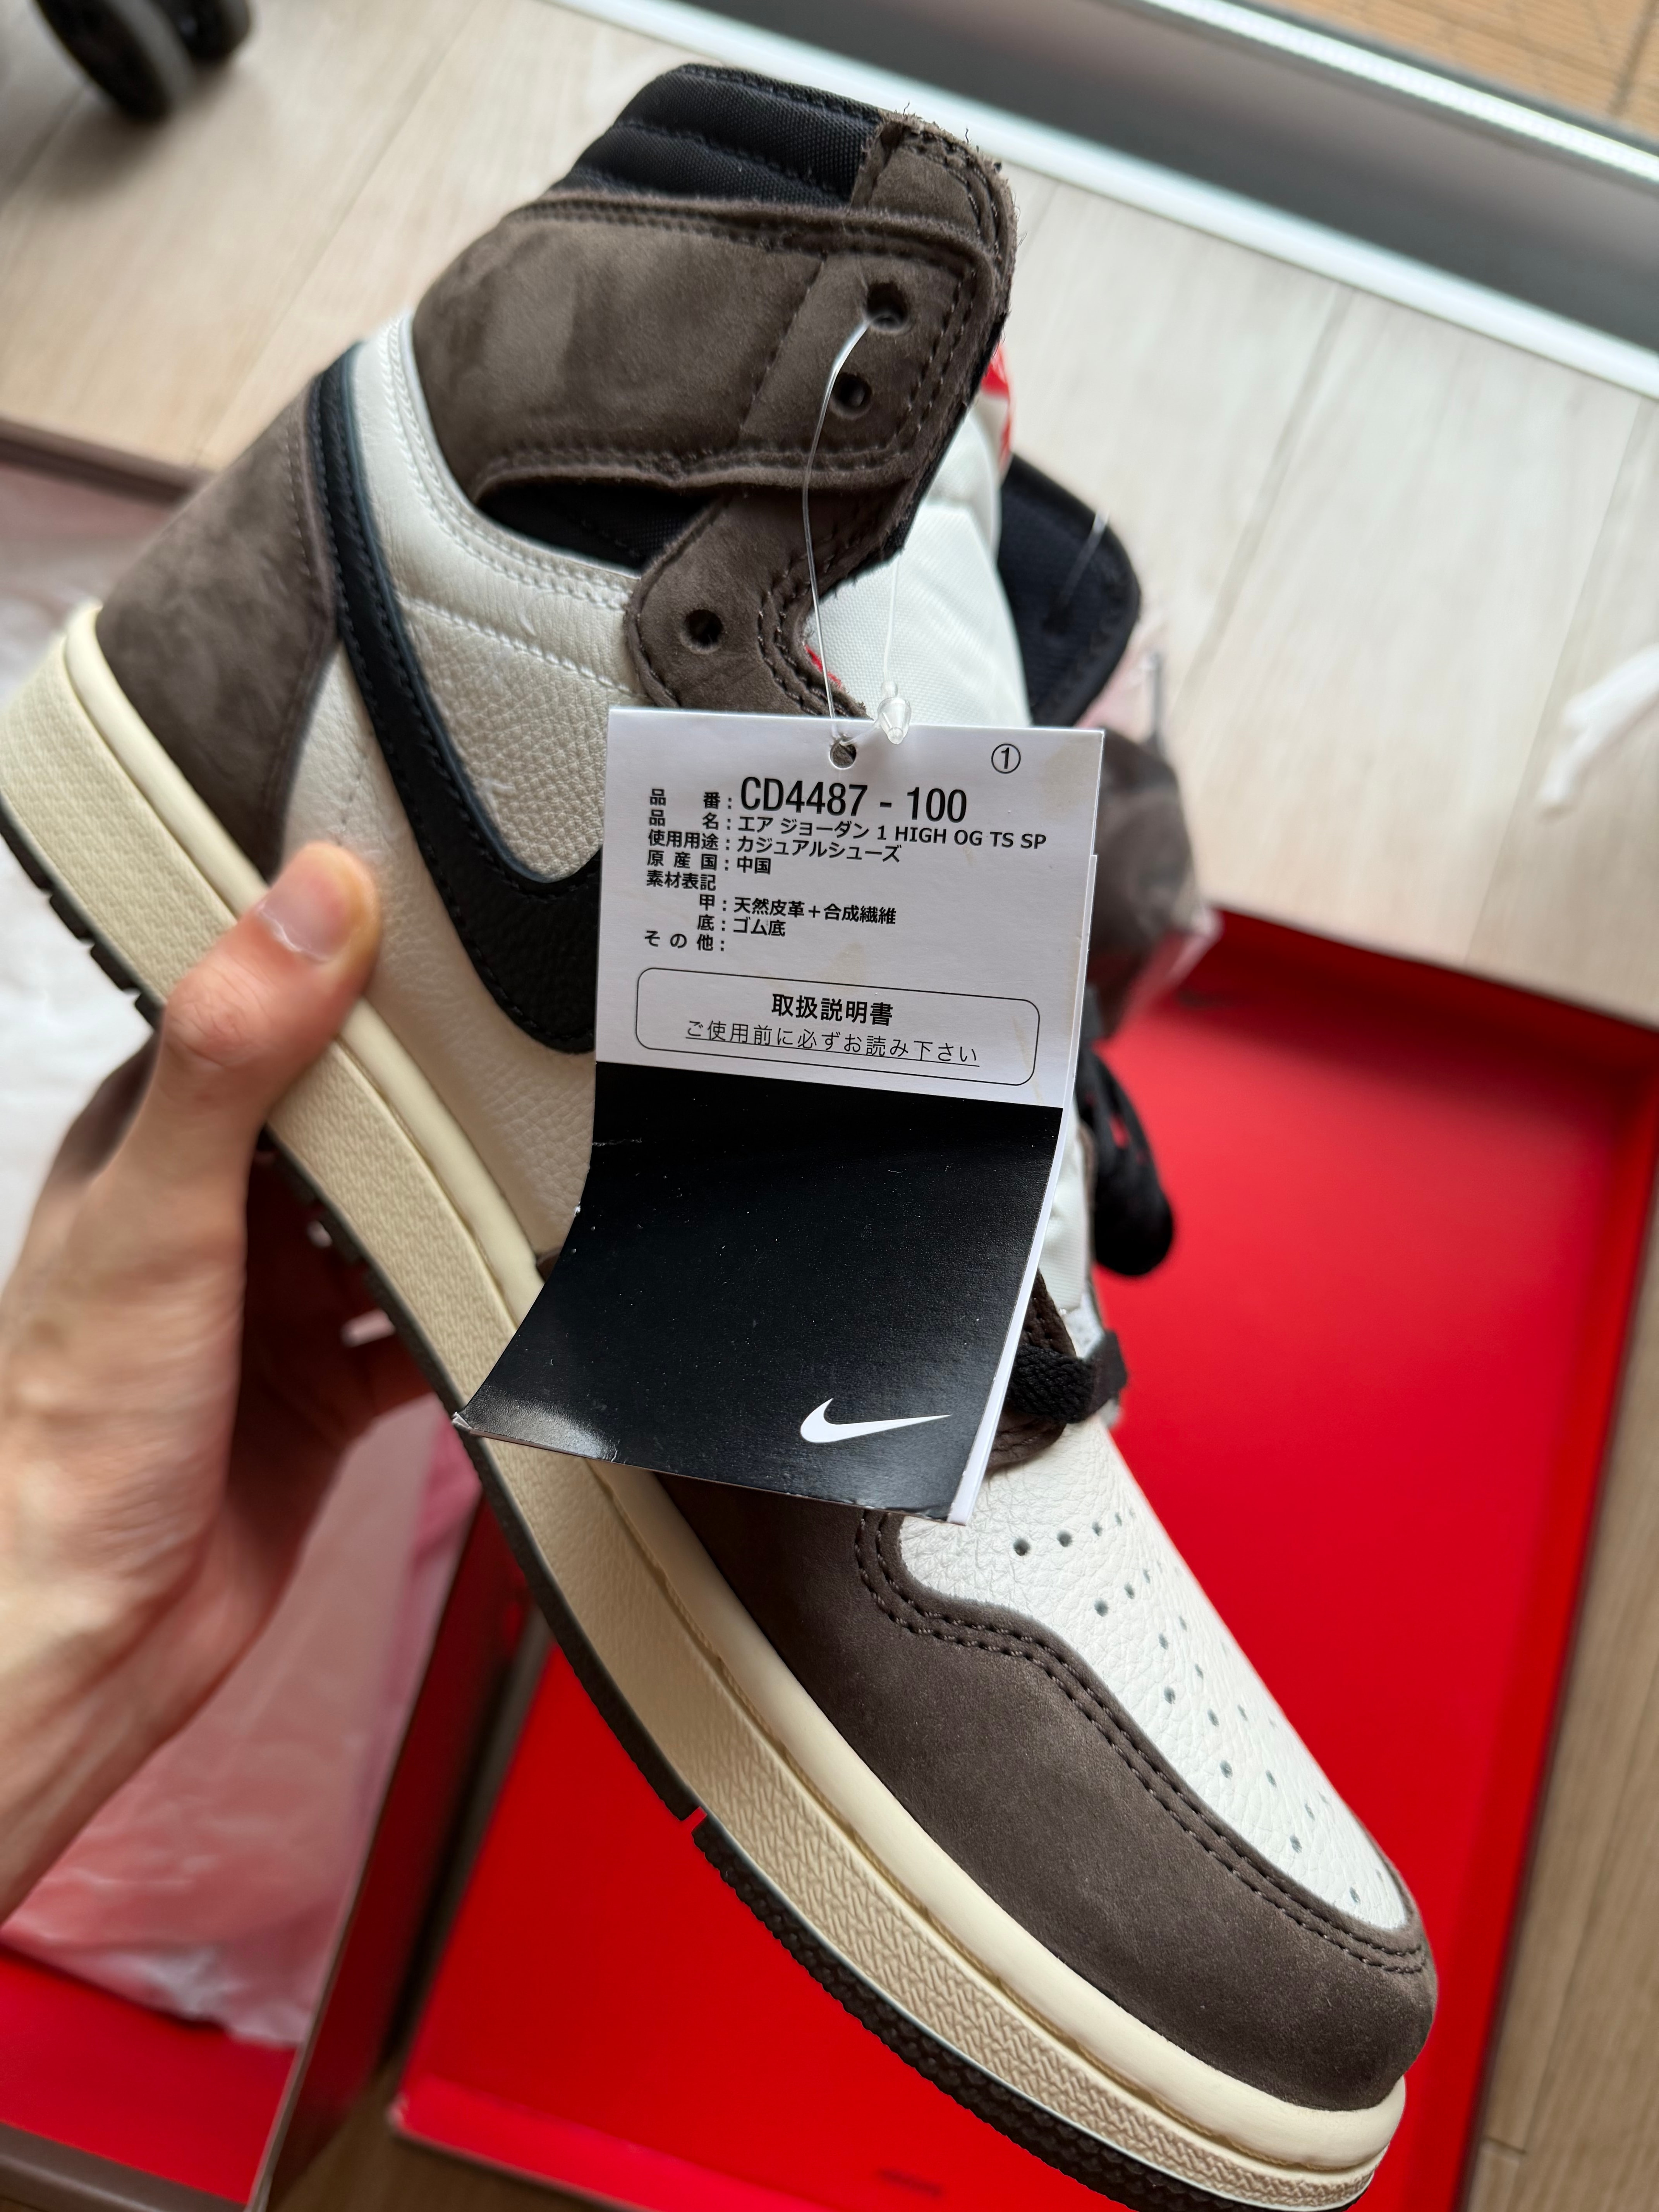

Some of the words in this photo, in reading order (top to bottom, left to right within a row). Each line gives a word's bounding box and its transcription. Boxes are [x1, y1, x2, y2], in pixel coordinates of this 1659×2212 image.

[740, 776, 868, 817] CD4487
[907, 787, 967, 823] 100
[738, 816, 774, 833] エア
[780, 818, 869, 839] ジョーダン
[877, 825, 886, 840] 1
[895, 826, 946, 844] HIGH
[954, 830, 982, 846] OG
[989, 831, 1014, 848] TS
[1020, 834, 1046, 849] SP
[646, 870, 716, 891] 素材表記
[771, 993, 893, 1026] 取扱説明書
[687, 1020, 977, 1062] ご使用前に必ずお読み下さい
